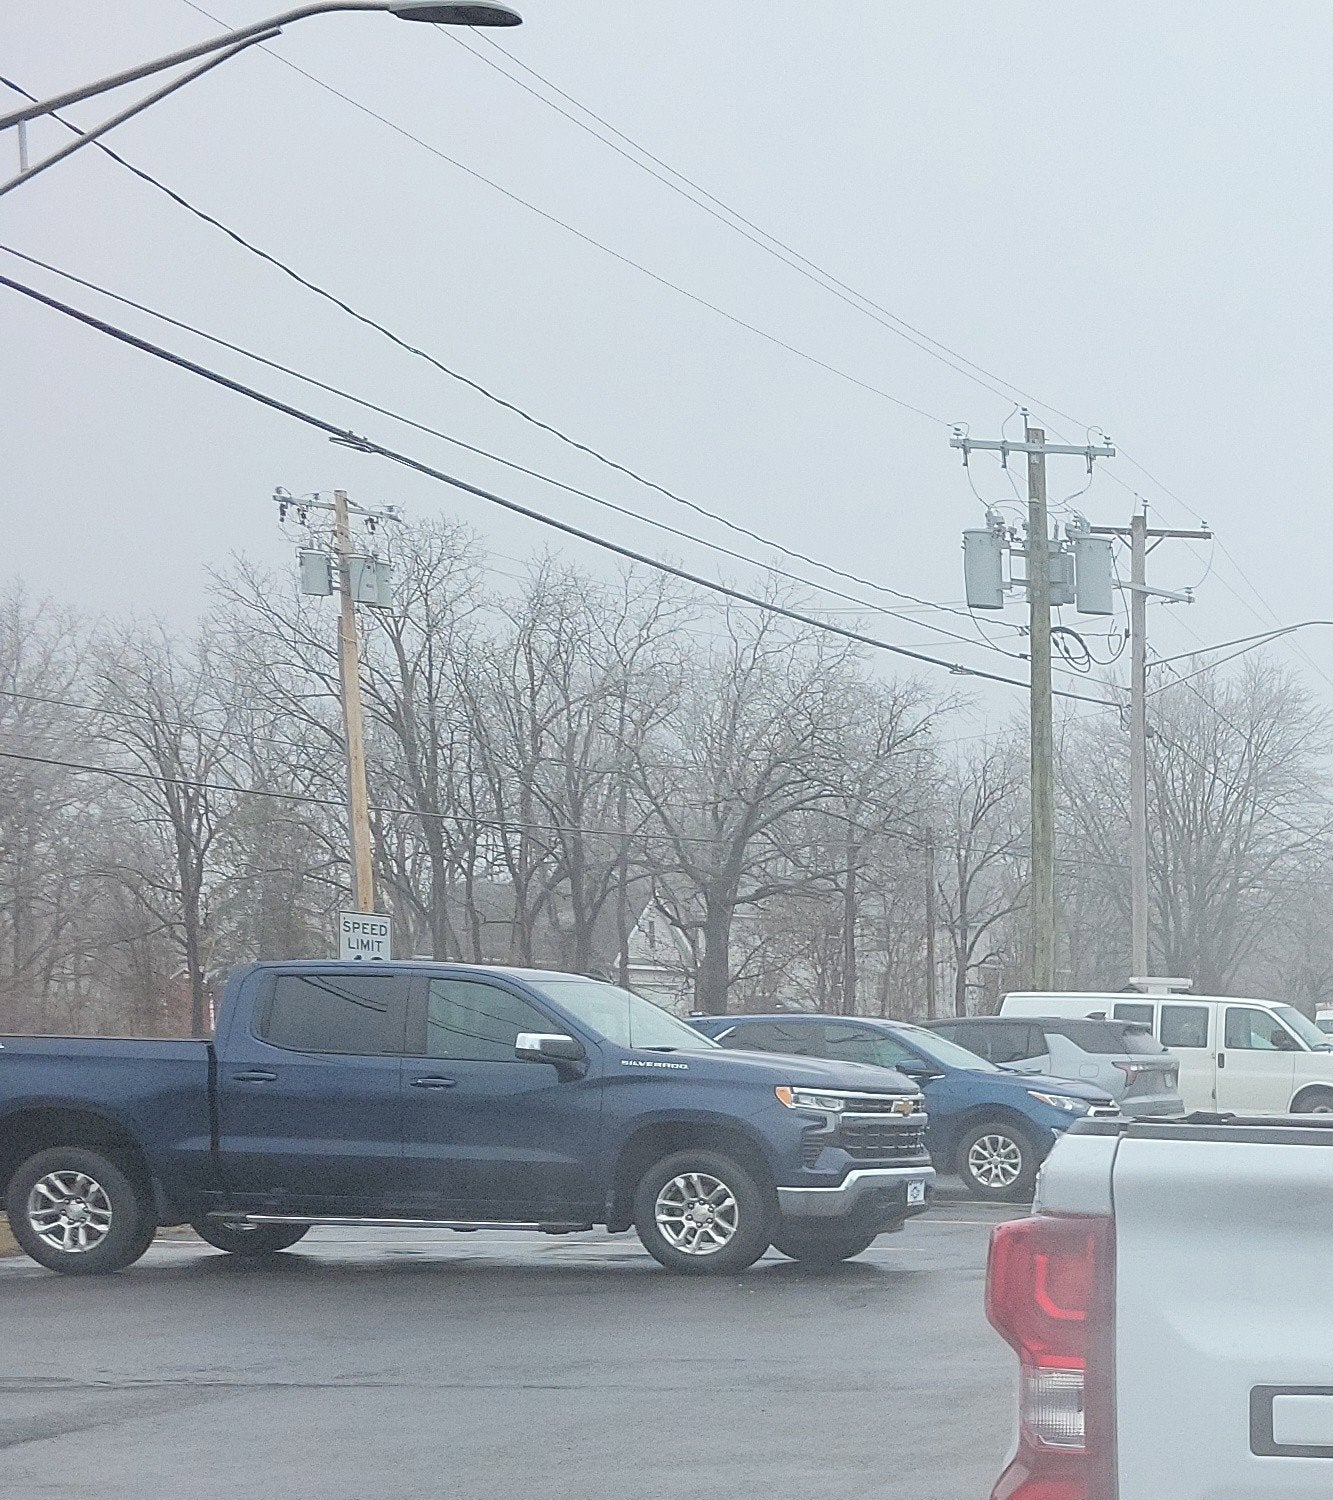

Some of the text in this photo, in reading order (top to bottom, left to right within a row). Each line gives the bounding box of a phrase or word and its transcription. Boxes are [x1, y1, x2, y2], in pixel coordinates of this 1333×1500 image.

[343, 920, 388, 937] SPEED
[348, 937, 383, 952] LIMIT
[621, 1059, 689, 1070] SILVERADO
